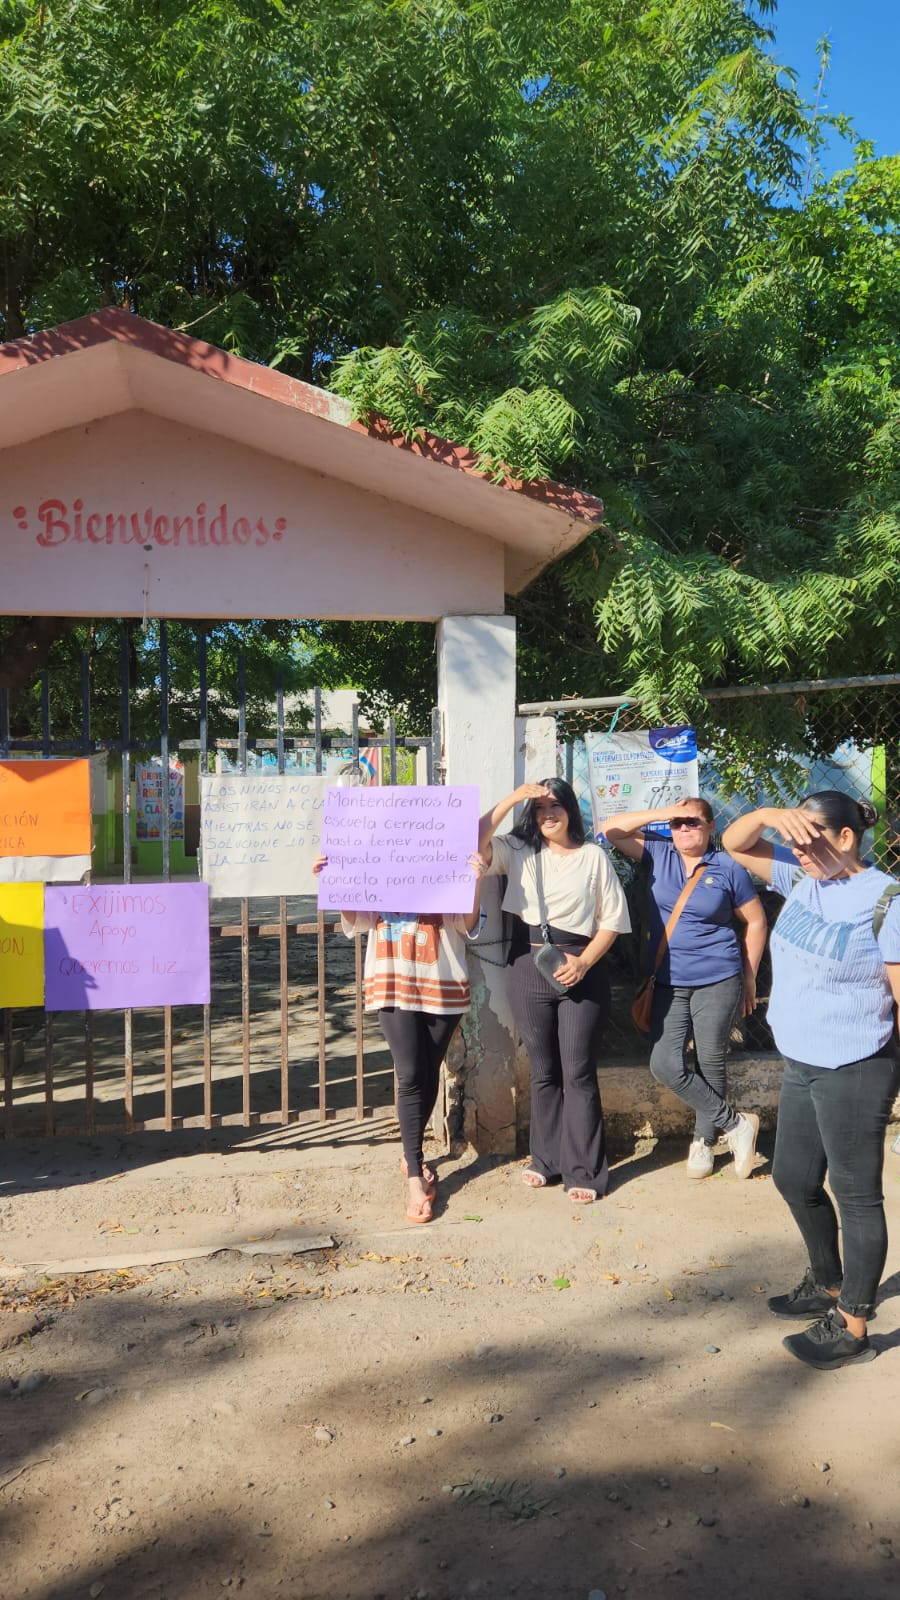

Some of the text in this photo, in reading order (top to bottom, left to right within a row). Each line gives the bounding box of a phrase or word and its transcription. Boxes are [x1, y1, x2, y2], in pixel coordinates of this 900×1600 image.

[36, 498, 270, 548] Bienvenidos
[142, 788, 176, 798] REGRO
[206, 782, 237, 797] LOS
[289, 784, 310, 794] NO
[301, 798, 325, 810] CLA
[327, 791, 463, 809] Mantendremos la
[144, 803, 174, 814] CLAS
[0, 810, 39, 827] CIÓN
[204, 820, 313, 832] MIENTRAS NO SE
[324, 815, 446, 832] escuela cerrada
[205, 837, 280, 850] SOLUCIONE
[325, 832, 444, 848] hasta tener una
[234, 852, 269, 865] LUZ
[389, 849, 459, 864] favorable
[322, 869, 472, 888] concreta para nuestra
[71, 890, 167, 918] Exijimos
[328, 889, 383, 904] escuela.
[88, 919, 137, 945] Apoyo
[0, 936, 25, 956] ON
[59, 955, 178, 976] Queremos luz
